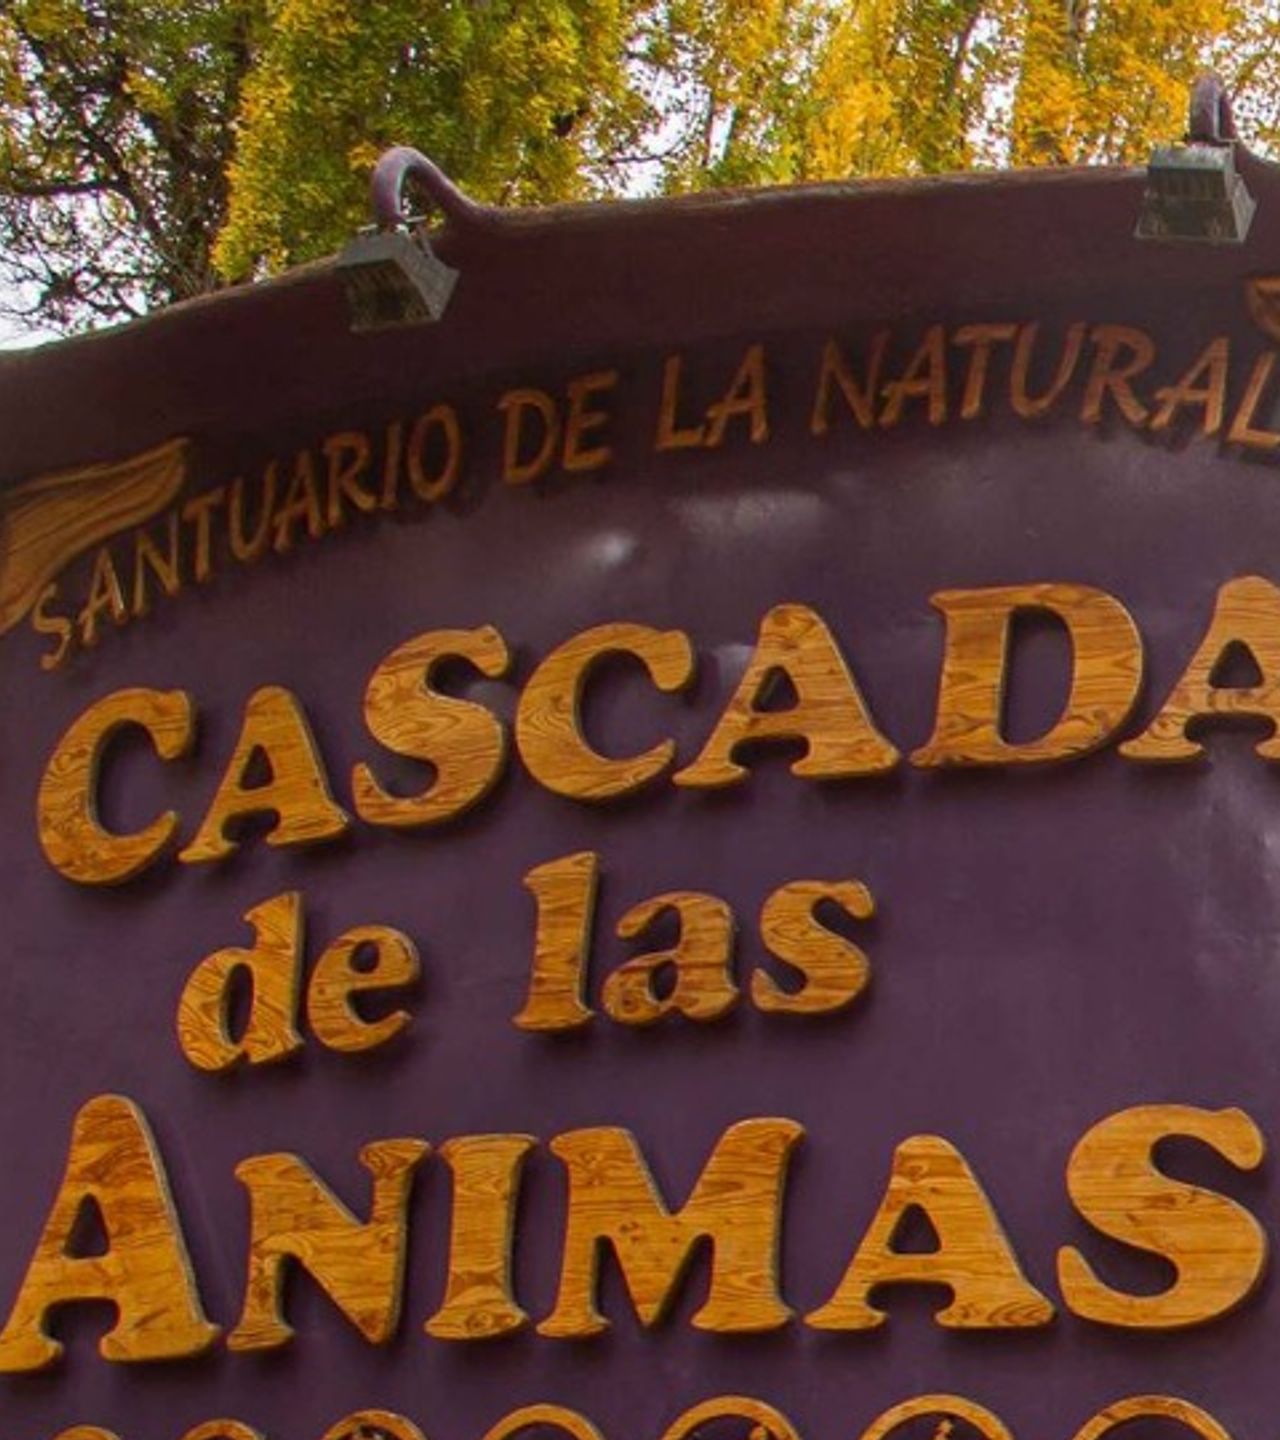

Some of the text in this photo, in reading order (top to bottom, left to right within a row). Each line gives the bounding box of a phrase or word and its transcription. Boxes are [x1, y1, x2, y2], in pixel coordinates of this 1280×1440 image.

[31, 403, 462, 671] SANTUARIO
[497, 369, 619, 484] DE
[653, 344, 771, 452] LA
[176, 850, 877, 1071] de las
[0, 1092, 1269, 1373] ANIMAS
